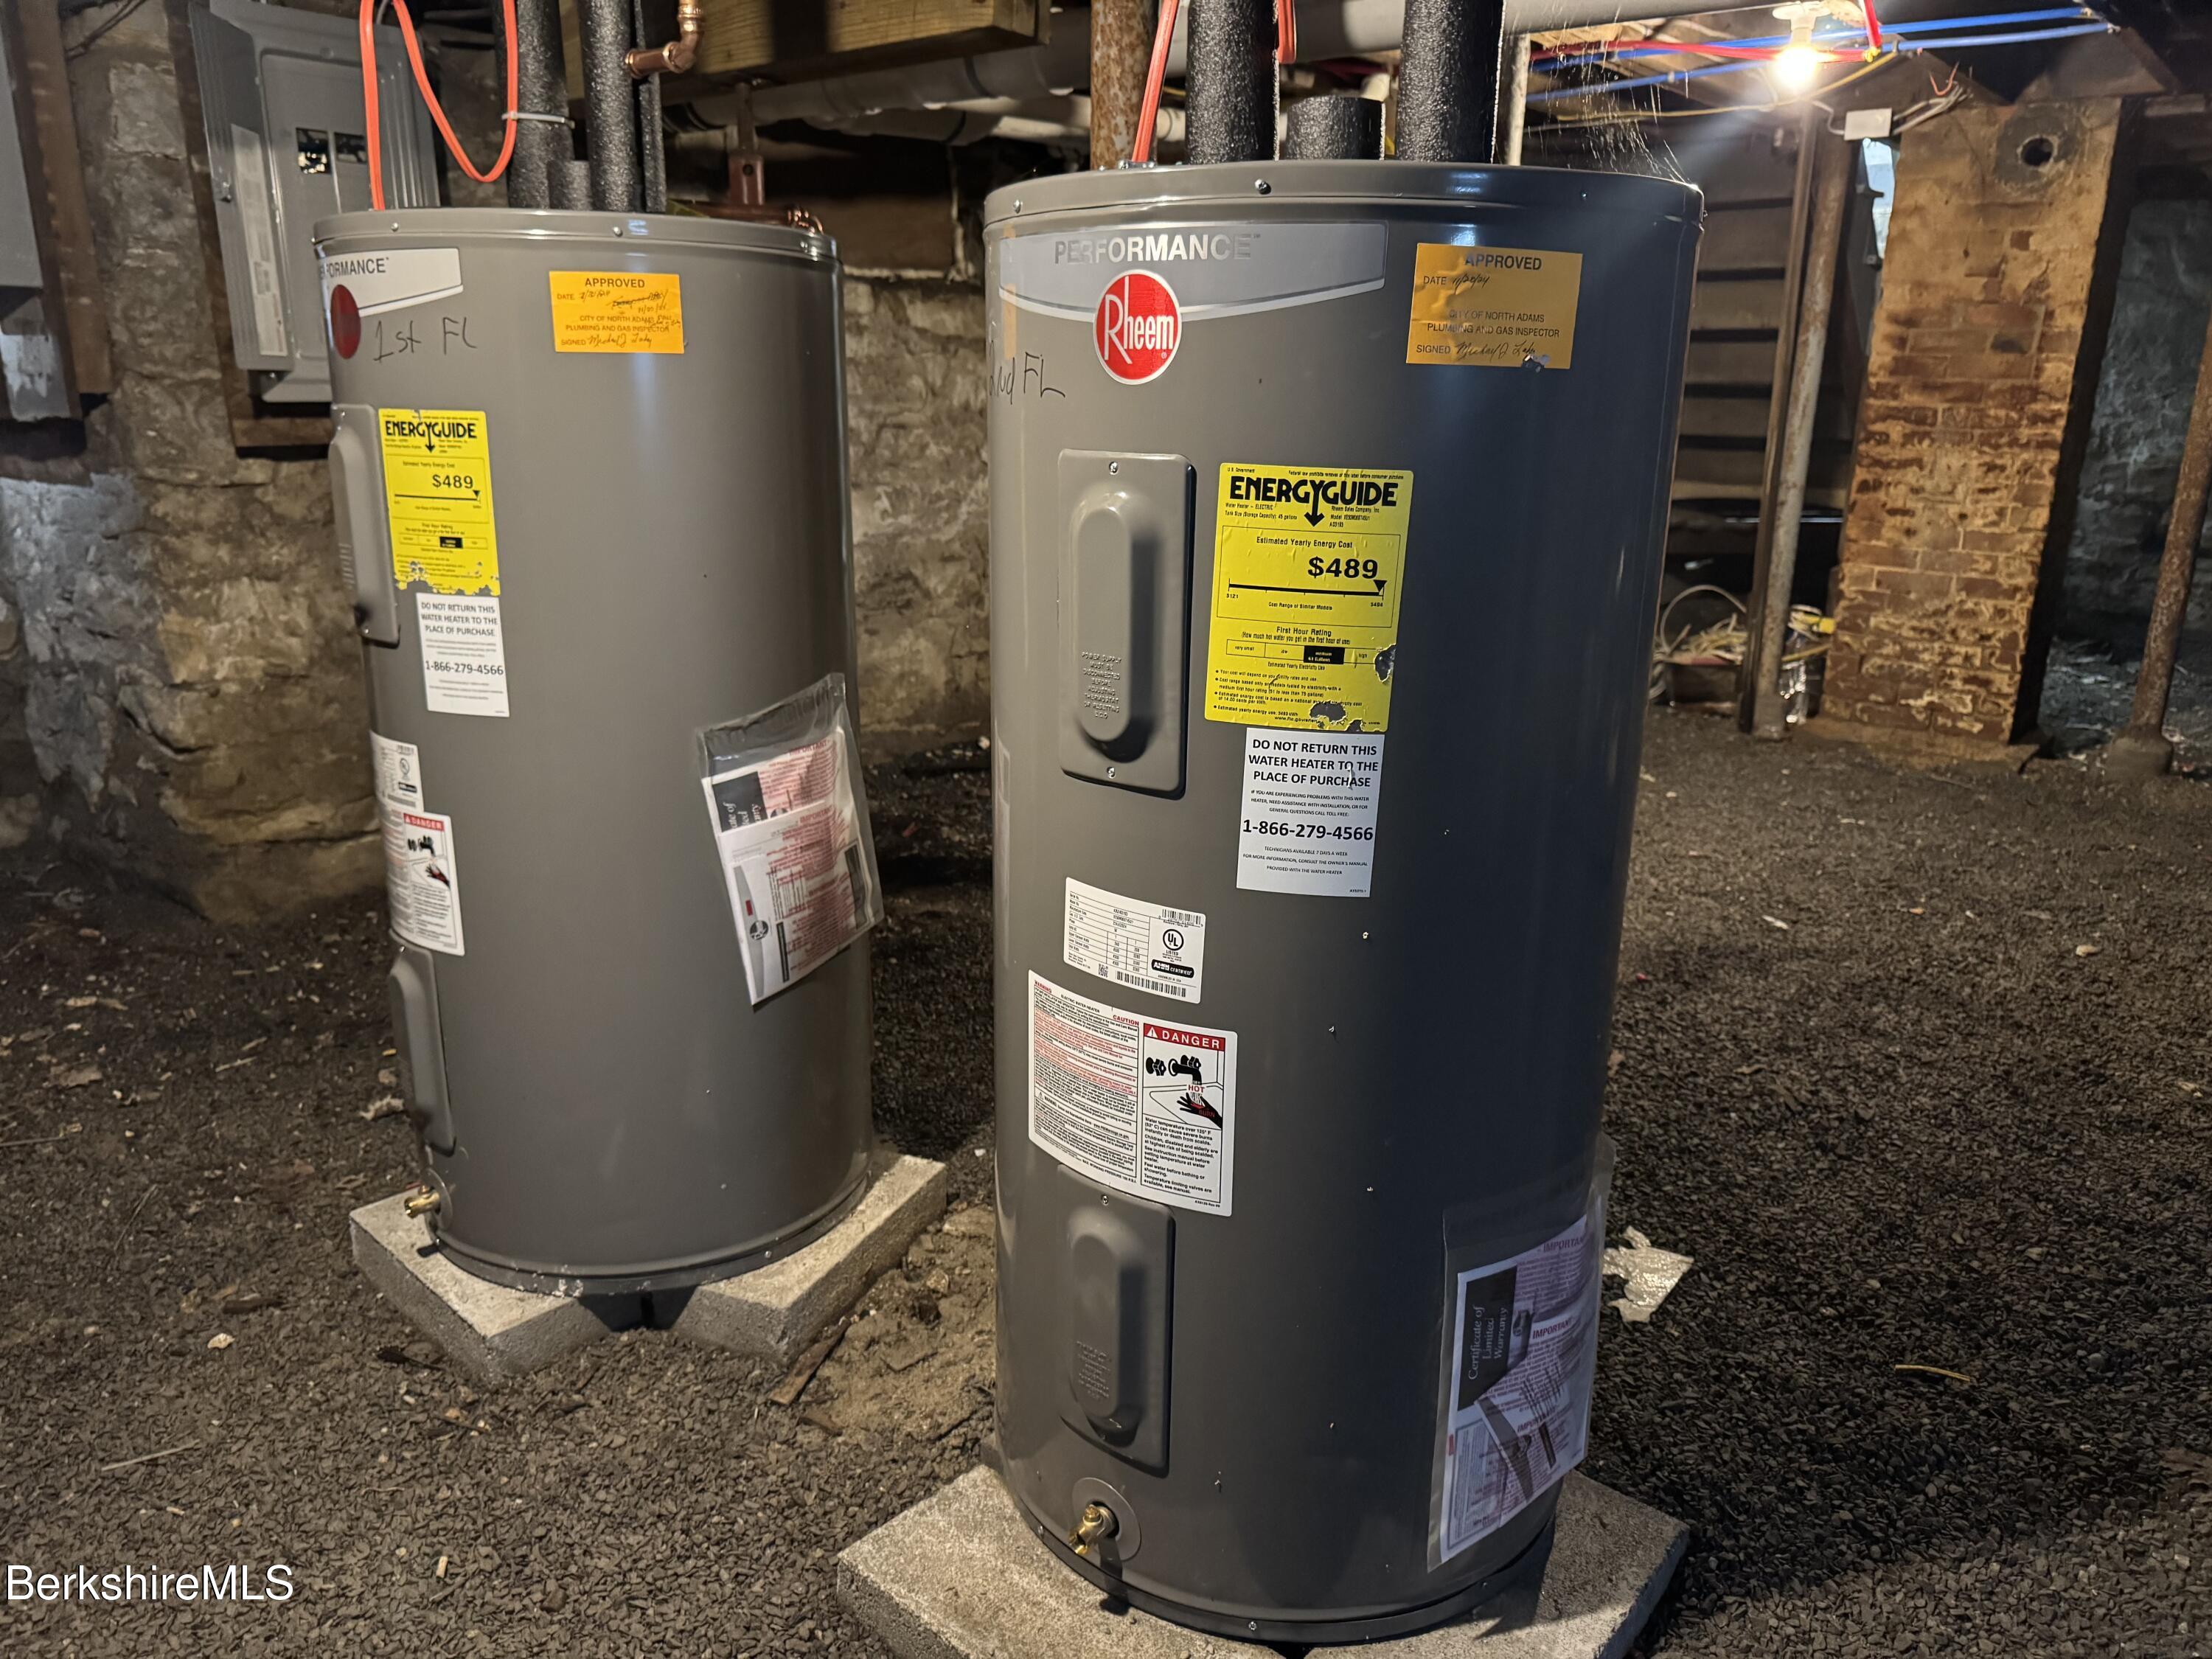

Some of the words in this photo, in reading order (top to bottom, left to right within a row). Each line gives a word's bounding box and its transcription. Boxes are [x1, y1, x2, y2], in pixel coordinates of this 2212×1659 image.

[1055, 234, 1251, 264] PERFORMANCE
[1464, 253, 1542, 270] APPROVED
[585, 278, 645, 288] APPROVED
[1423, 276, 1447, 285] DATE
[1104, 276, 1174, 364] Rheem
[1449, 309, 1470, 320] CITY
[1471, 310, 1484, 319] OF
[1485, 311, 1515, 321] NORTH
[1516, 313, 1544, 323] ADAMS
[1427, 323, 1473, 335] PLUMBING
[1475, 325, 1494, 335] AND
[1495, 326, 1513, 335] GAS
[1515, 327, 1559, 338] INSPECTOR
[374, 320, 421, 363] 1st
[1416, 344, 1451, 354] SIGNED
[1023, 352, 1065, 397] FL
[385, 420, 477, 439] ENERGYGUIDE
[432, 474, 473, 489] $489
[1230, 476, 1399, 507] ENERGYGUIDE
[1256, 536, 1288, 545] Estimated
[1290, 538, 1311, 548] Yearly
[1314, 540, 1336, 549] Energy
[1338, 540, 1352, 549] Cost
[1307, 556, 1378, 579] $489
[448, 604, 476, 612] RETURN
[478, 605, 495, 613] THIS
[471, 616, 482, 625] TO
[483, 617, 498, 625] THE
[425, 625, 444, 633] PLACE
[456, 627, 495, 636] PURCHASE
[1276, 626, 1290, 634] First
[1311, 628, 1332, 637] Rating
[425, 661, 504, 675] 1-866-279-4566
[1253, 739, 1270, 749] DO
[1273, 741, 1298, 751] NOT
[1301, 743, 1348, 754] RETURN
[1352, 745, 1377, 755] THIS
[1248, 754, 1287, 767] WATER
[1291, 758, 1335, 770] HEATER
[1338, 761, 1354, 771] TO
[1357, 762, 1379, 771] THE
[1253, 771, 1288, 782] PLACE
[1291, 774, 1307, 784] OF
[1310, 775, 1371, 787] PURCHASE
[1243, 819, 1373, 841] 1-866-279-4566
[1113, 1015, 1139, 1026] CAUTION
[1162, 1030, 1220, 1048] DANGER
[1188, 1085, 1205, 1093] HOT
[1198, 1109, 1215, 1117] BURN
[1472, 1304, 1486, 1318] of
[1482, 1318, 1494, 1359] Limited
[1468, 1321, 1481, 1380] Certificate
